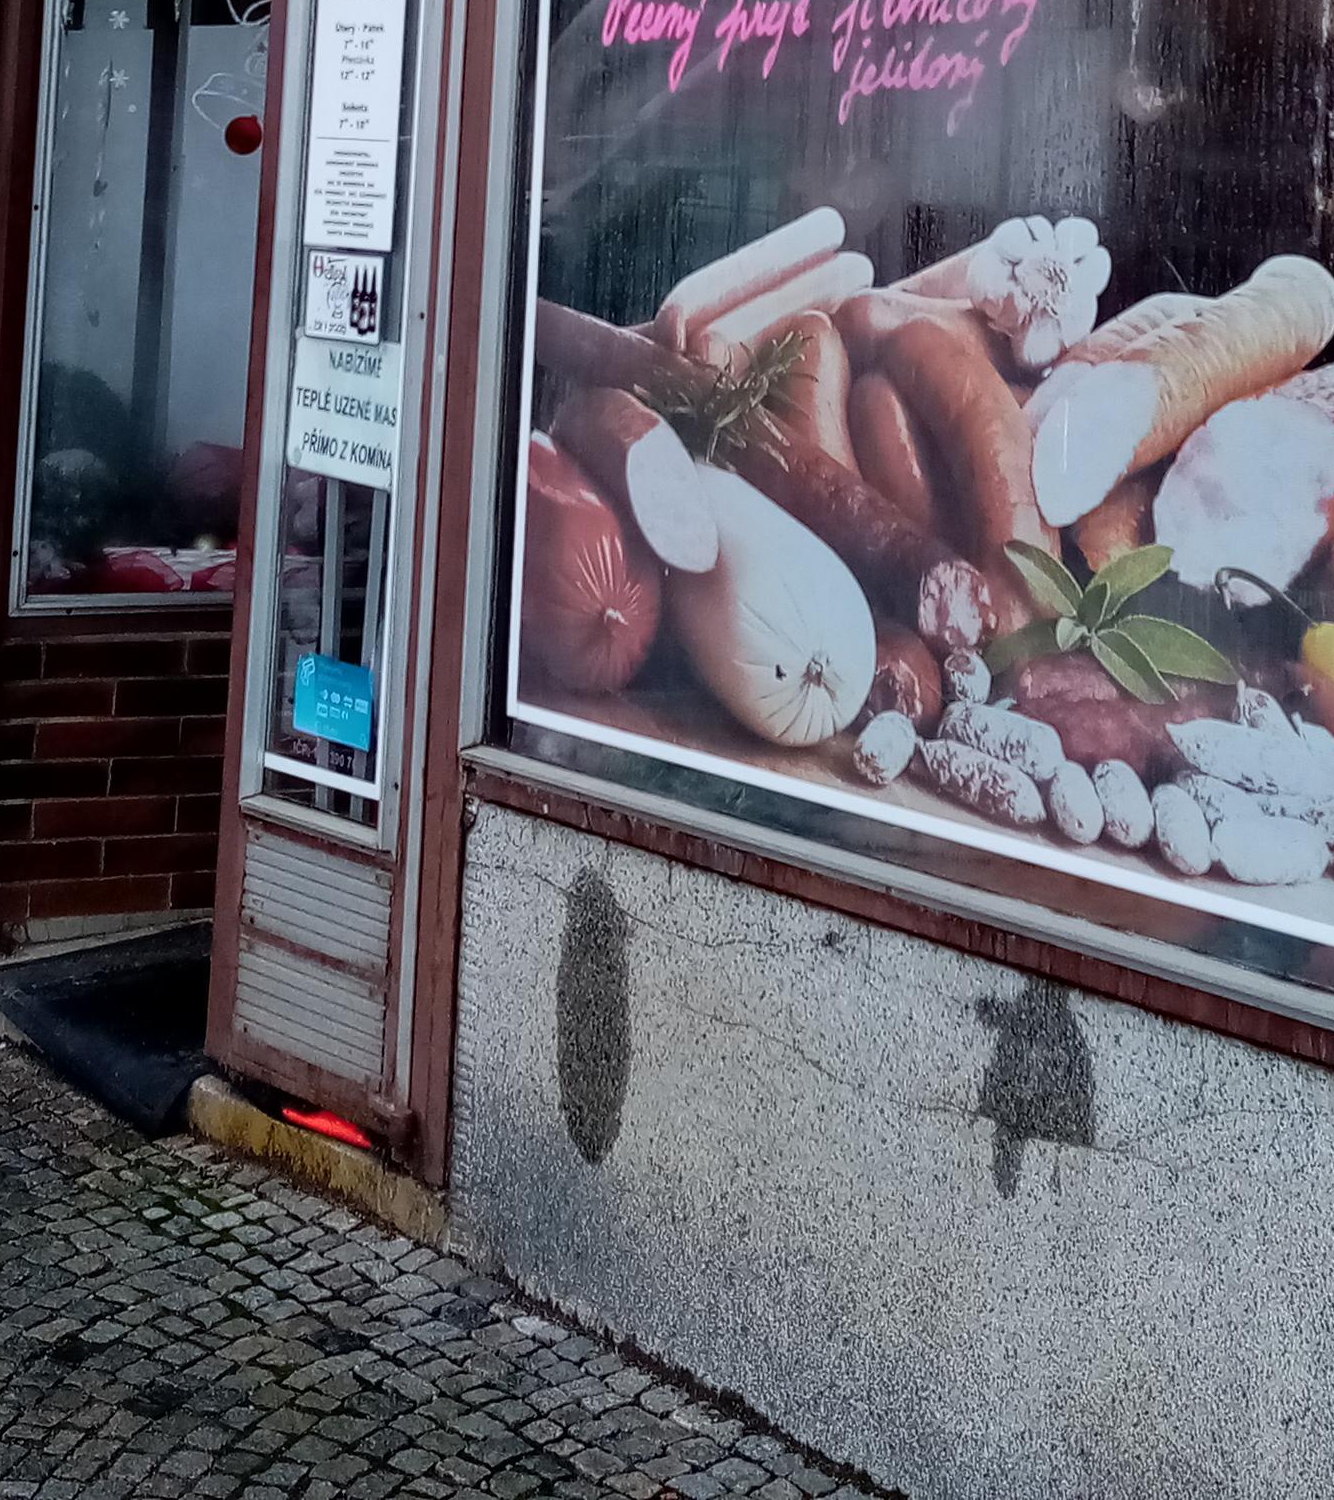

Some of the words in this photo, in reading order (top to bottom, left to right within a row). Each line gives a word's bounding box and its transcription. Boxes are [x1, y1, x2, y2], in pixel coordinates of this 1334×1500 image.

[296, 387, 331, 412] TEPLÉ
[334, 395, 371, 421] UZENÉ
[301, 428, 338, 457] PŘÍMO
[339, 441, 348, 460] Z
[350, 442, 393, 471] KOMÍNA
